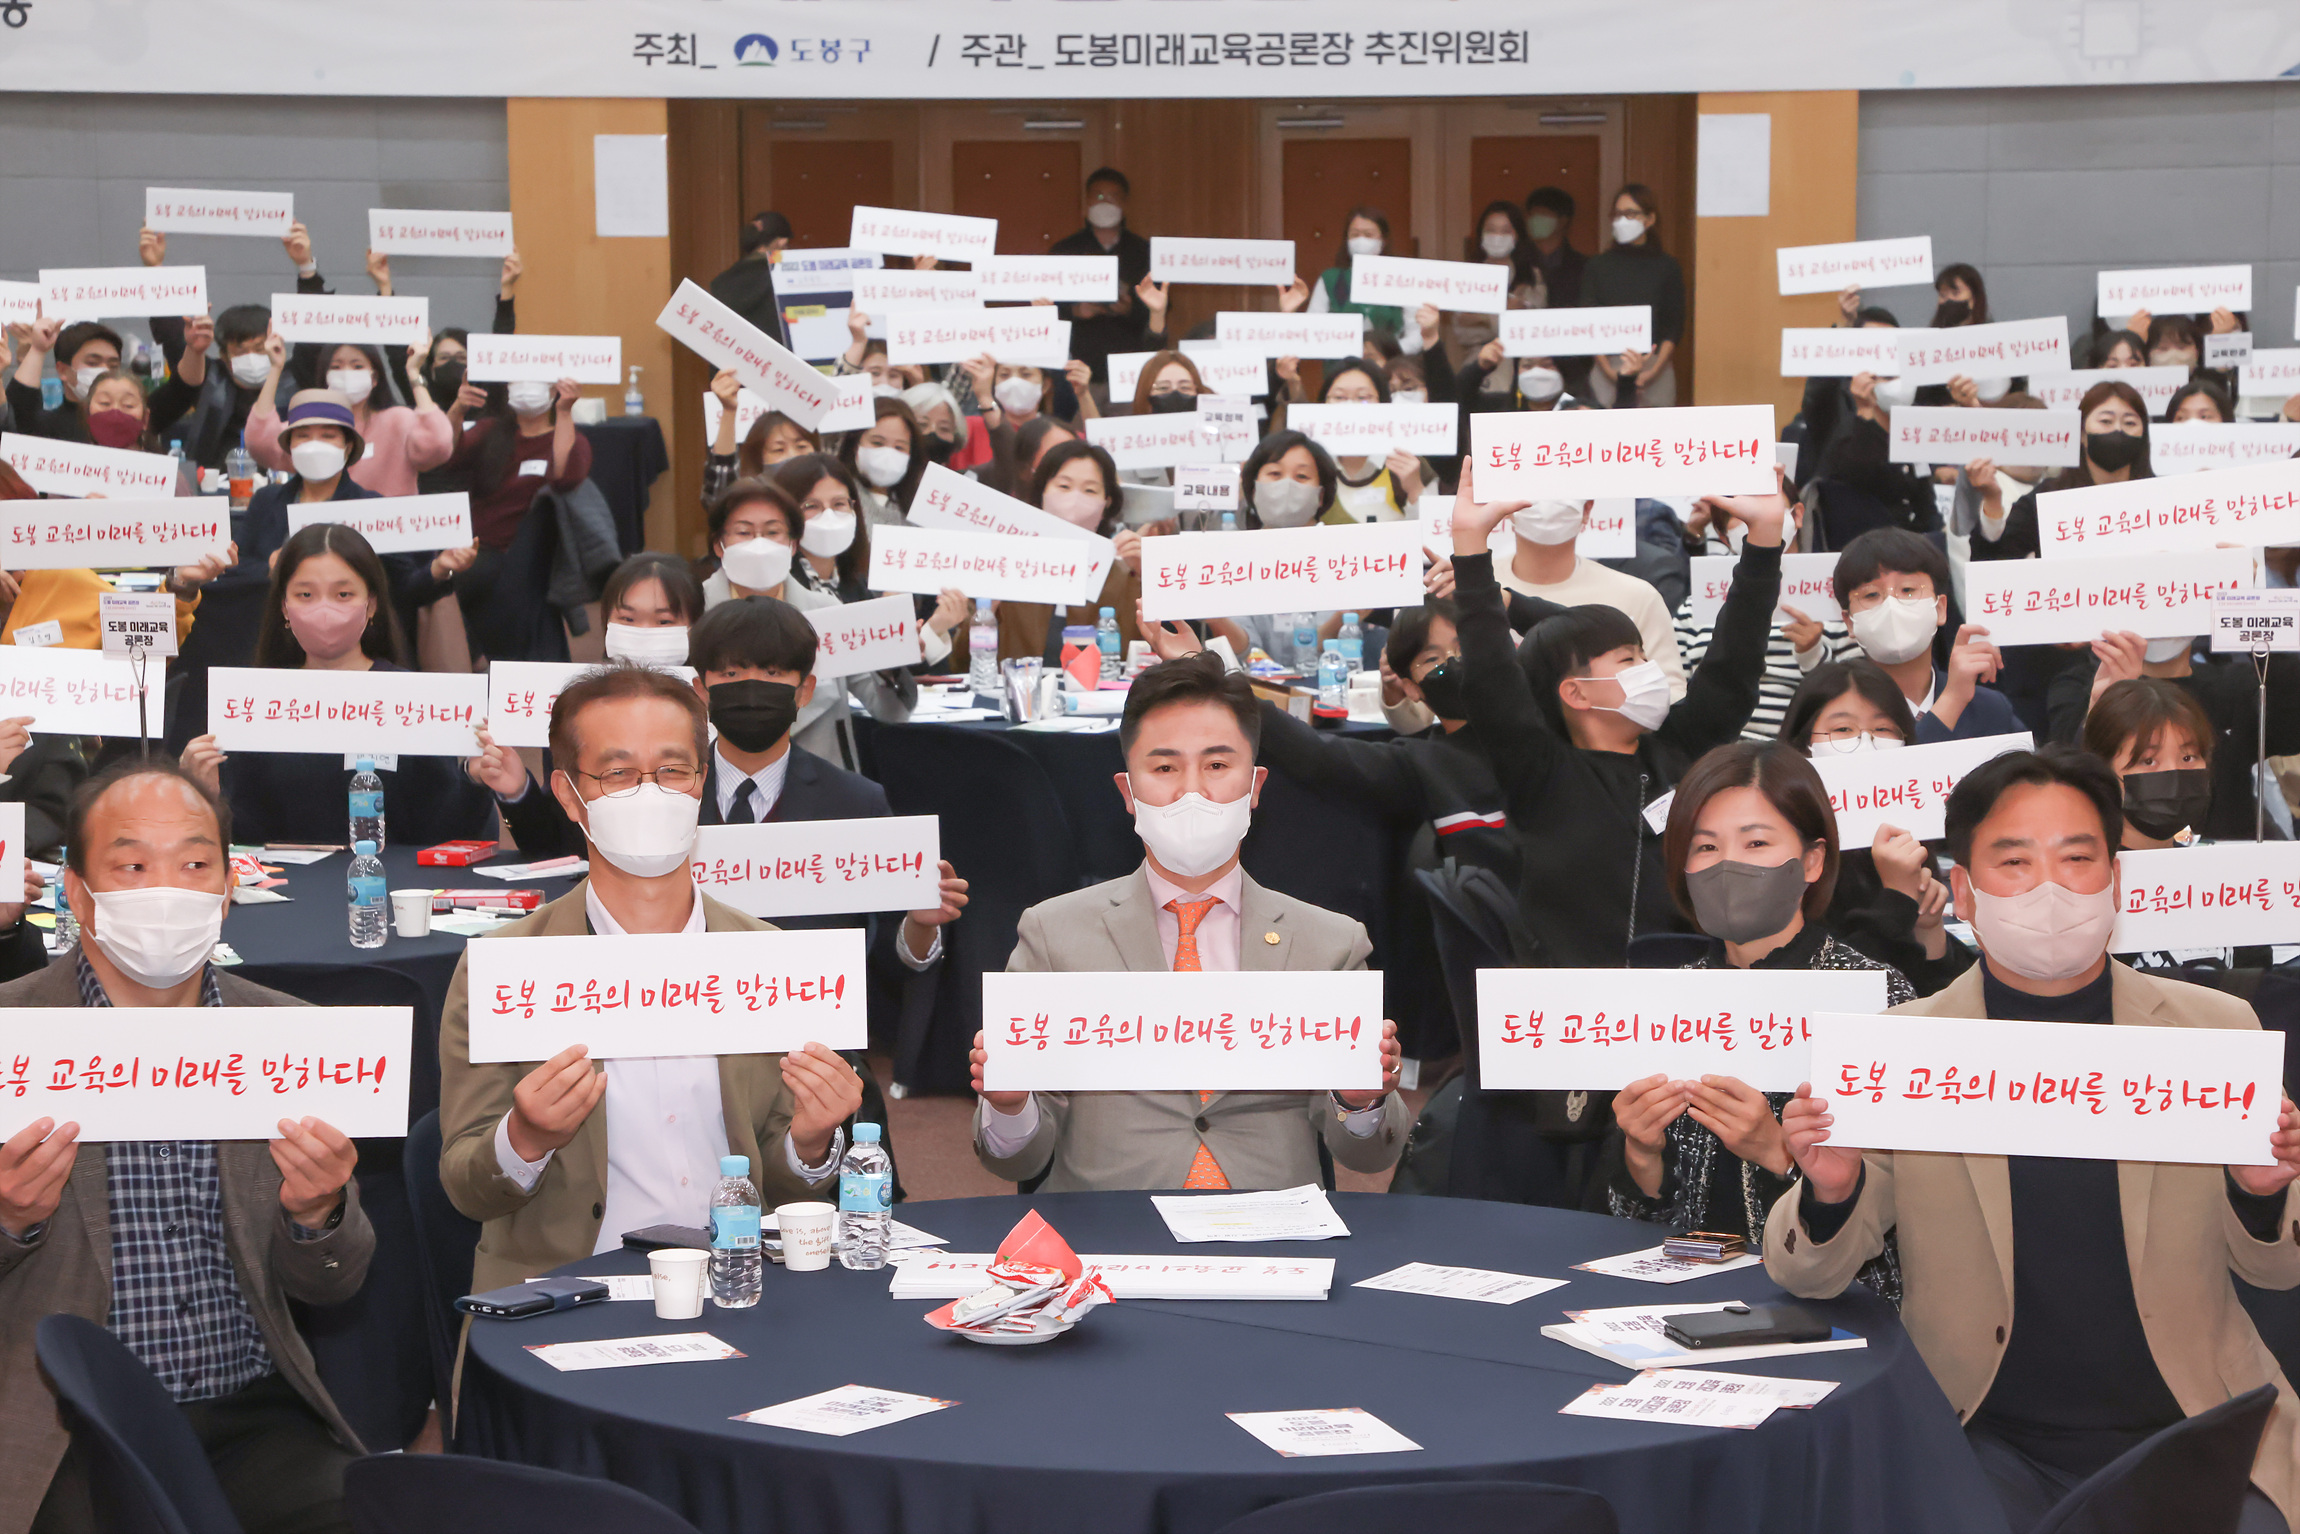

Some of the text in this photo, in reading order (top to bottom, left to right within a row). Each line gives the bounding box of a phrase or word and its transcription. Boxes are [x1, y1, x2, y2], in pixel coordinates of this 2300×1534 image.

[792, 39, 872, 64] 도봉구
[1055, 33, 1354, 68] 도봉미래교육공론장
[1364, 31, 1530, 67] 추진위원회
[52, 284, 197, 302] 도봉 교육의 미래를 말하다!
[282, 312, 419, 328] 도봉 교육의 미래를 말하다!
[898, 326, 1050, 345] 도봉 교육의 미래를 말하다!
[676, 304, 822, 408] 도봉 교육의 미래를 말하다!
[1909, 339, 2058, 367] 도봉 교육의 미래를 말하다!
[1901, 427, 2070, 446] 도봉 교육의 미래를 말하다!
[1490, 438, 1758, 470] 도봉 교육의 미래를 말하다!
[10, 455, 166, 487] 도봉 교육의 미래를 말하다!
[367, 514, 460, 533] 미래를 말하다!
[927, 489, 998, 532] 도봉 교육의
[2056, 492, 2299, 542] 도봉 교육의 미래를 말하다
[12, 522, 217, 546] 도봉 교육의 미래를 말하다!
[883, 550, 1076, 578] 도봉 교육의 미래를 말하다!
[1158, 553, 1406, 590] 도봉 교육의 미래를 말하다!
[1983, 590, 2013, 616] 도봉
[2024, 588, 2080, 611] 교육의
[2089, 583, 2146, 610] 미래를
[108, 621, 168, 633] 도봉 미래교육
[842, 622, 904, 650] 말하다!
[2220, 616, 2293, 628] 도봉 미래교육
[2239, 630, 2274, 642] 공론장
[124, 634, 153, 647] 공론장
[224, 697, 472, 726] 도봉 교육의 미래를 말하다!
[505, 691, 534, 717] 도봉
[1857, 779, 1924, 809] 미래를
[690, 852, 922, 887] 교육의 미래를 말하다!
[2127, 879, 2272, 913] 교육의 미래를
[492, 974, 845, 1018] 도봉 교육의 미래를 말하다!
[1006, 1013, 1361, 1050] 도봉 교육의 미래를 말하다!
[1502, 1010, 1811, 1051] 도봉 교육의 미래를 말하
[46, 1056, 139, 1093] 교육의
[152, 1054, 246, 1095] 미래를
[263, 1054, 386, 1093] 말하다!
[1836, 1062, 2255, 1115] 도봉 교육의 미래를 말하다!
